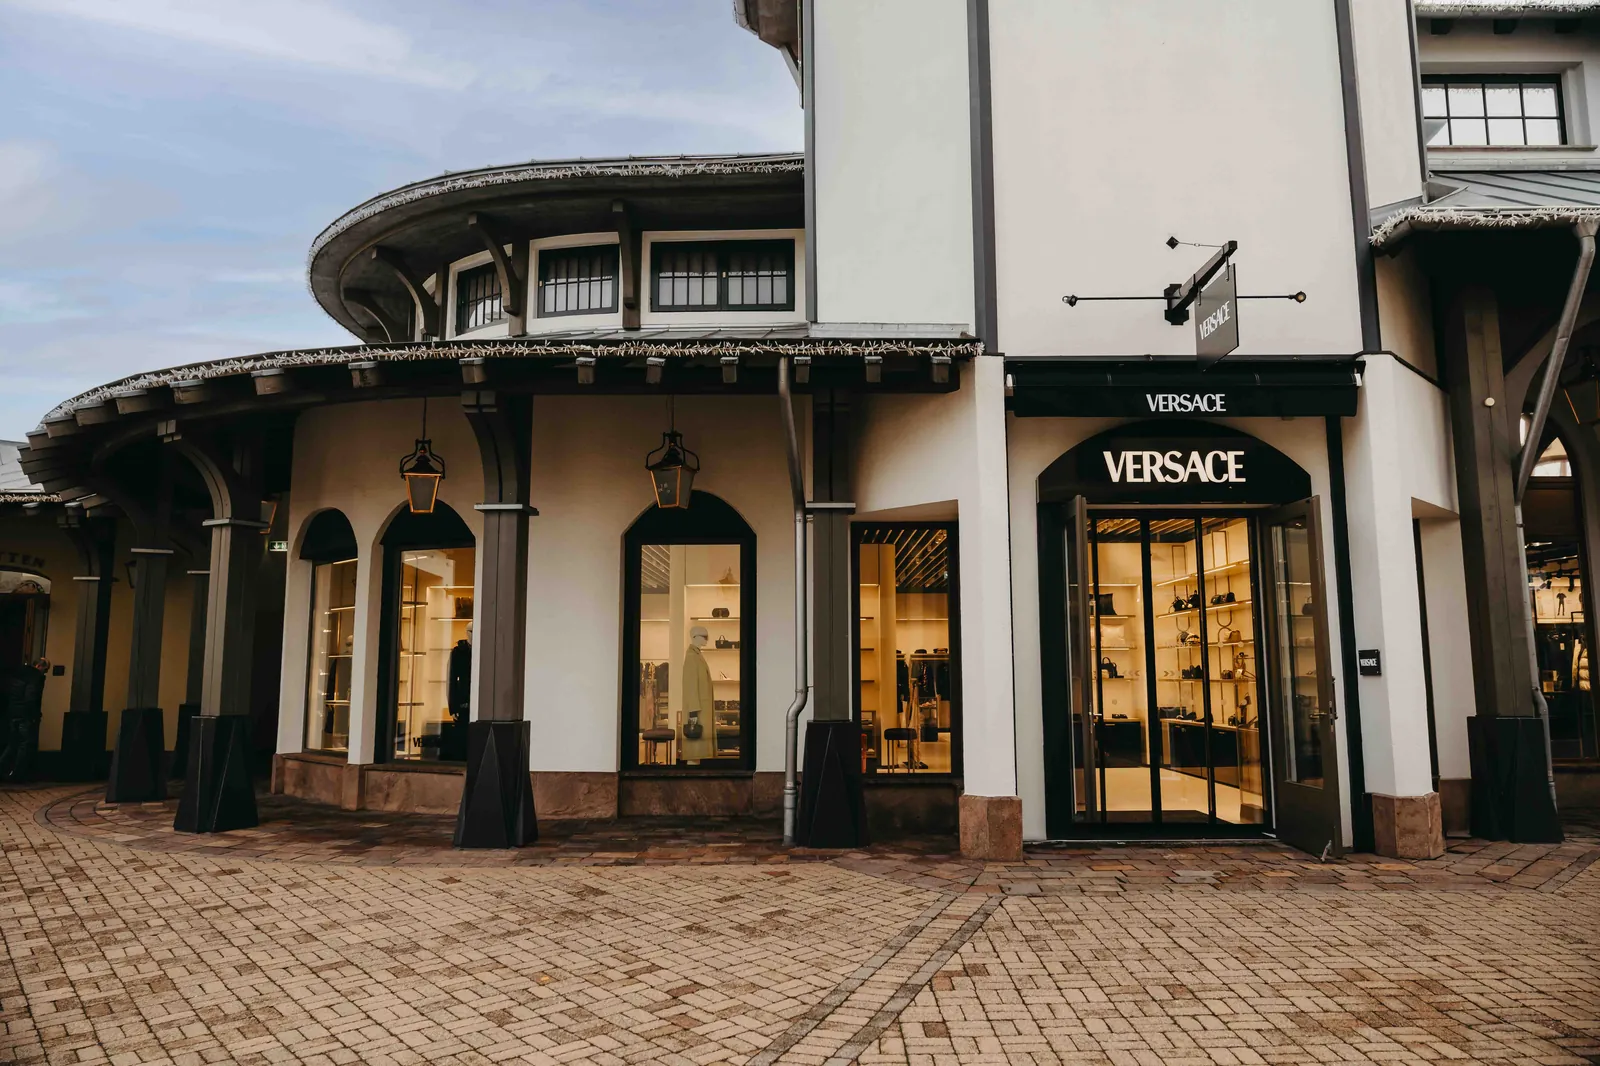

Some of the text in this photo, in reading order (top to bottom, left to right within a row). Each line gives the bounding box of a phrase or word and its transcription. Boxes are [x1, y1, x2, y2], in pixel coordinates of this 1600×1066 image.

[1199, 300, 1231, 341] VERSACE
[1145, 393, 1227, 412] VERSACE
[1102, 450, 1247, 484] VERSACE
